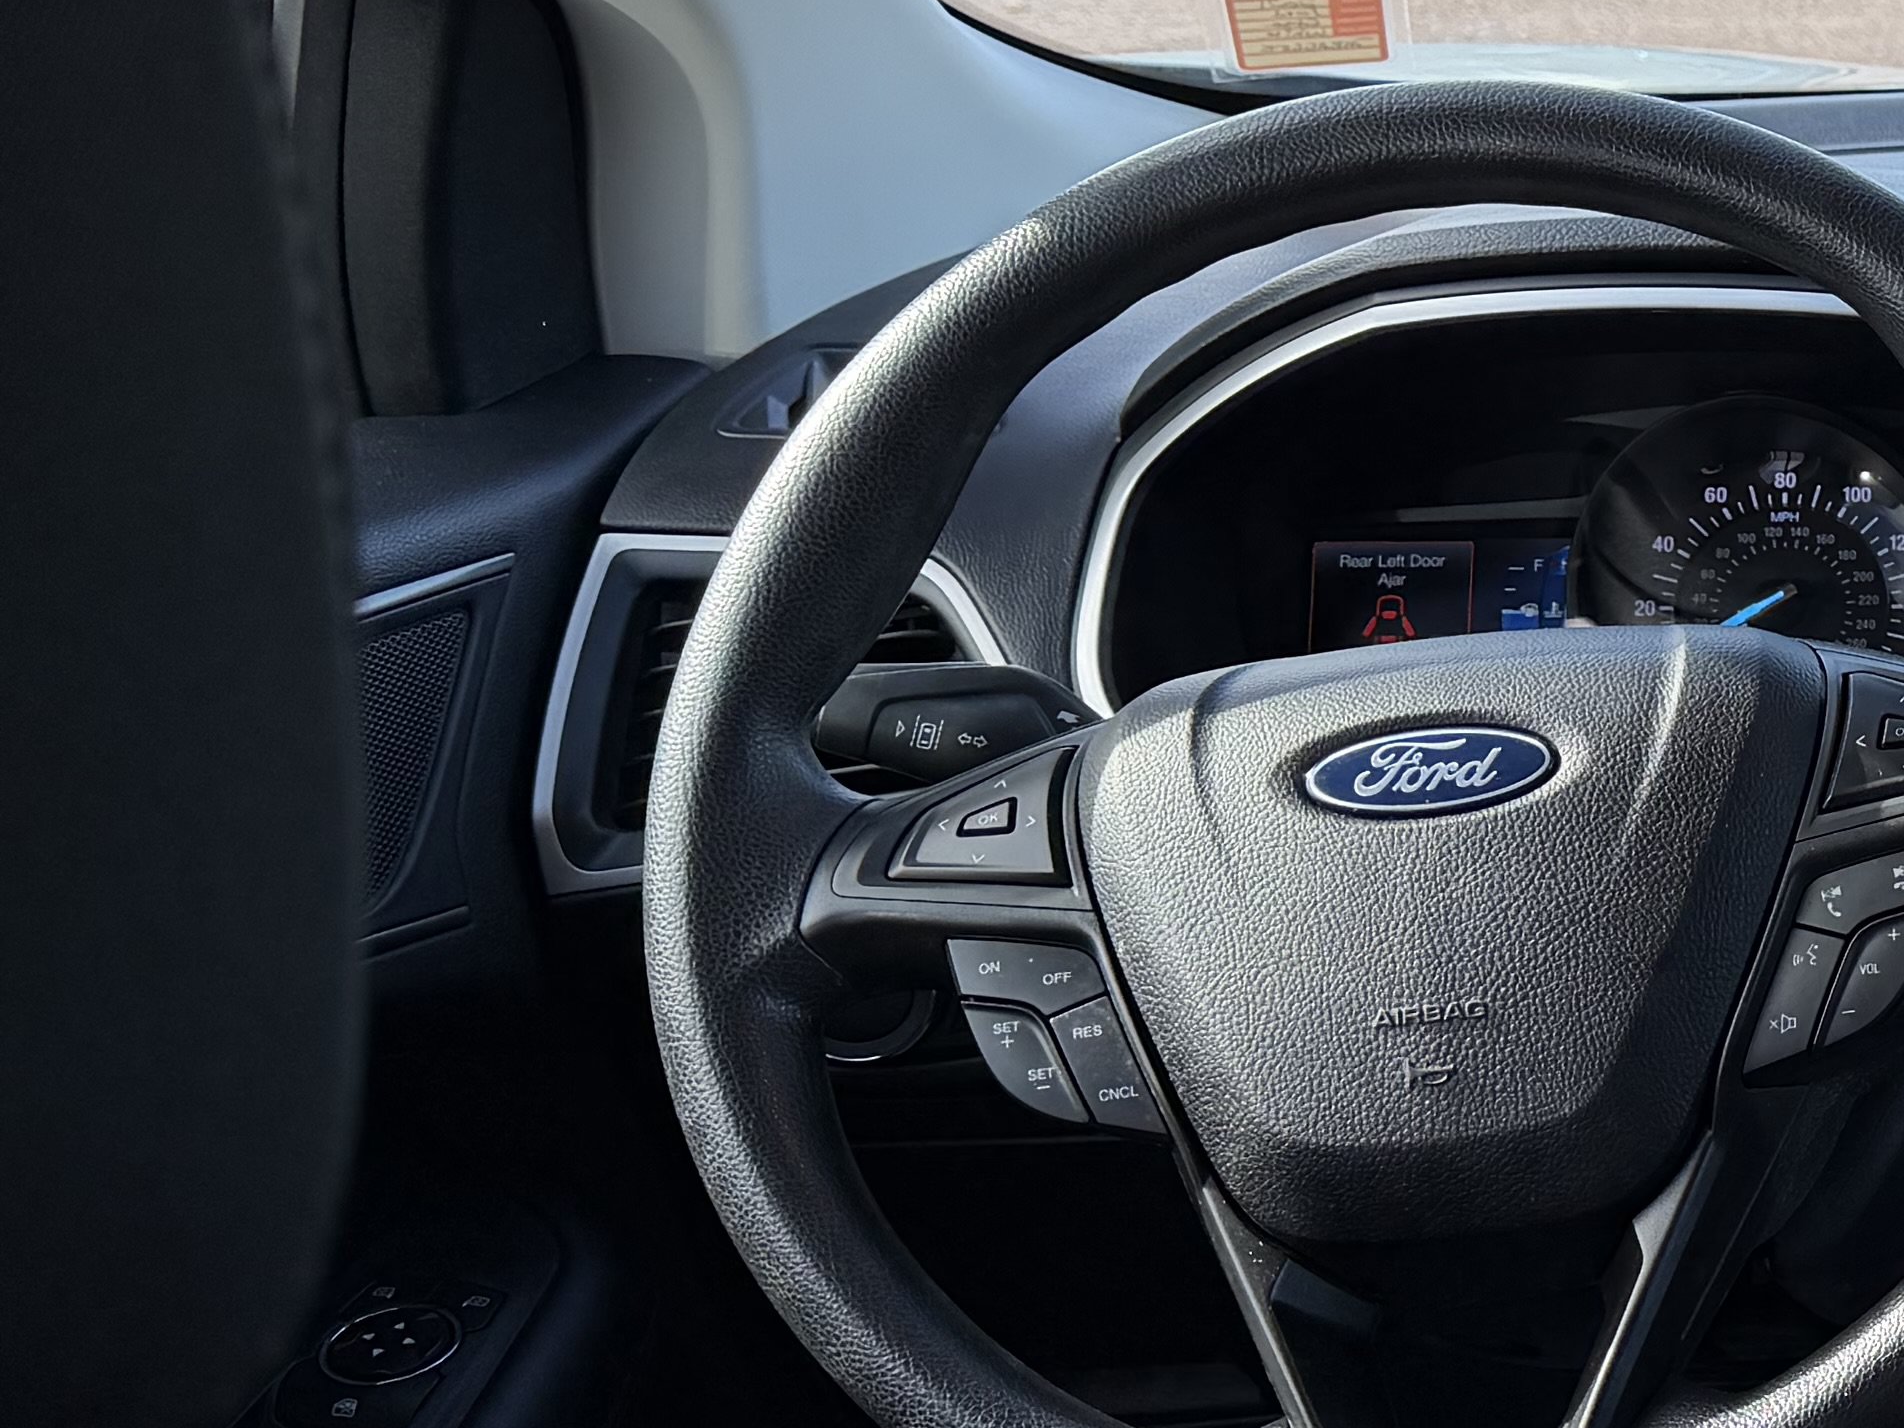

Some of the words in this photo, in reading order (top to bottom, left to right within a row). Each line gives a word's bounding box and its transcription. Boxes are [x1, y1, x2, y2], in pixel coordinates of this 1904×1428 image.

[1774, 472, 1797, 489] 80
[1704, 487, 1728, 504] 60
[1843, 486, 1872, 503] 100
[1770, 511, 1800, 523] MPH
[1763, 526, 1783, 538] 120
[1790, 526, 1810, 538] 140
[1816, 533, 1835, 545] 160
[1652, 535, 1675, 552] 40
[1340, 554, 1373, 568] Rear
[1378, 554, 1405, 568] Left
[1410, 554, 1446, 568] Door
[1534, 558, 1545, 571] F
[1377, 573, 1406, 587] Ajar
[1853, 571, 1874, 582] 200
[1634, 600, 1656, 617] 20
[1354, 738, 1502, 797] Ford
[978, 812, 998, 825] OK
[979, 961, 1000, 975] ON
[1042, 971, 1072, 985] OFF
[1859, 963, 1881, 975] VOL
[1371, 1000, 1488, 1027] AIRBAG
[992, 1021, 1019, 1034] SET
[1072, 1025, 1102, 1040] RES
[1027, 1067, 1054, 1081] SET
[1099, 1086, 1139, 1102] CNCL
